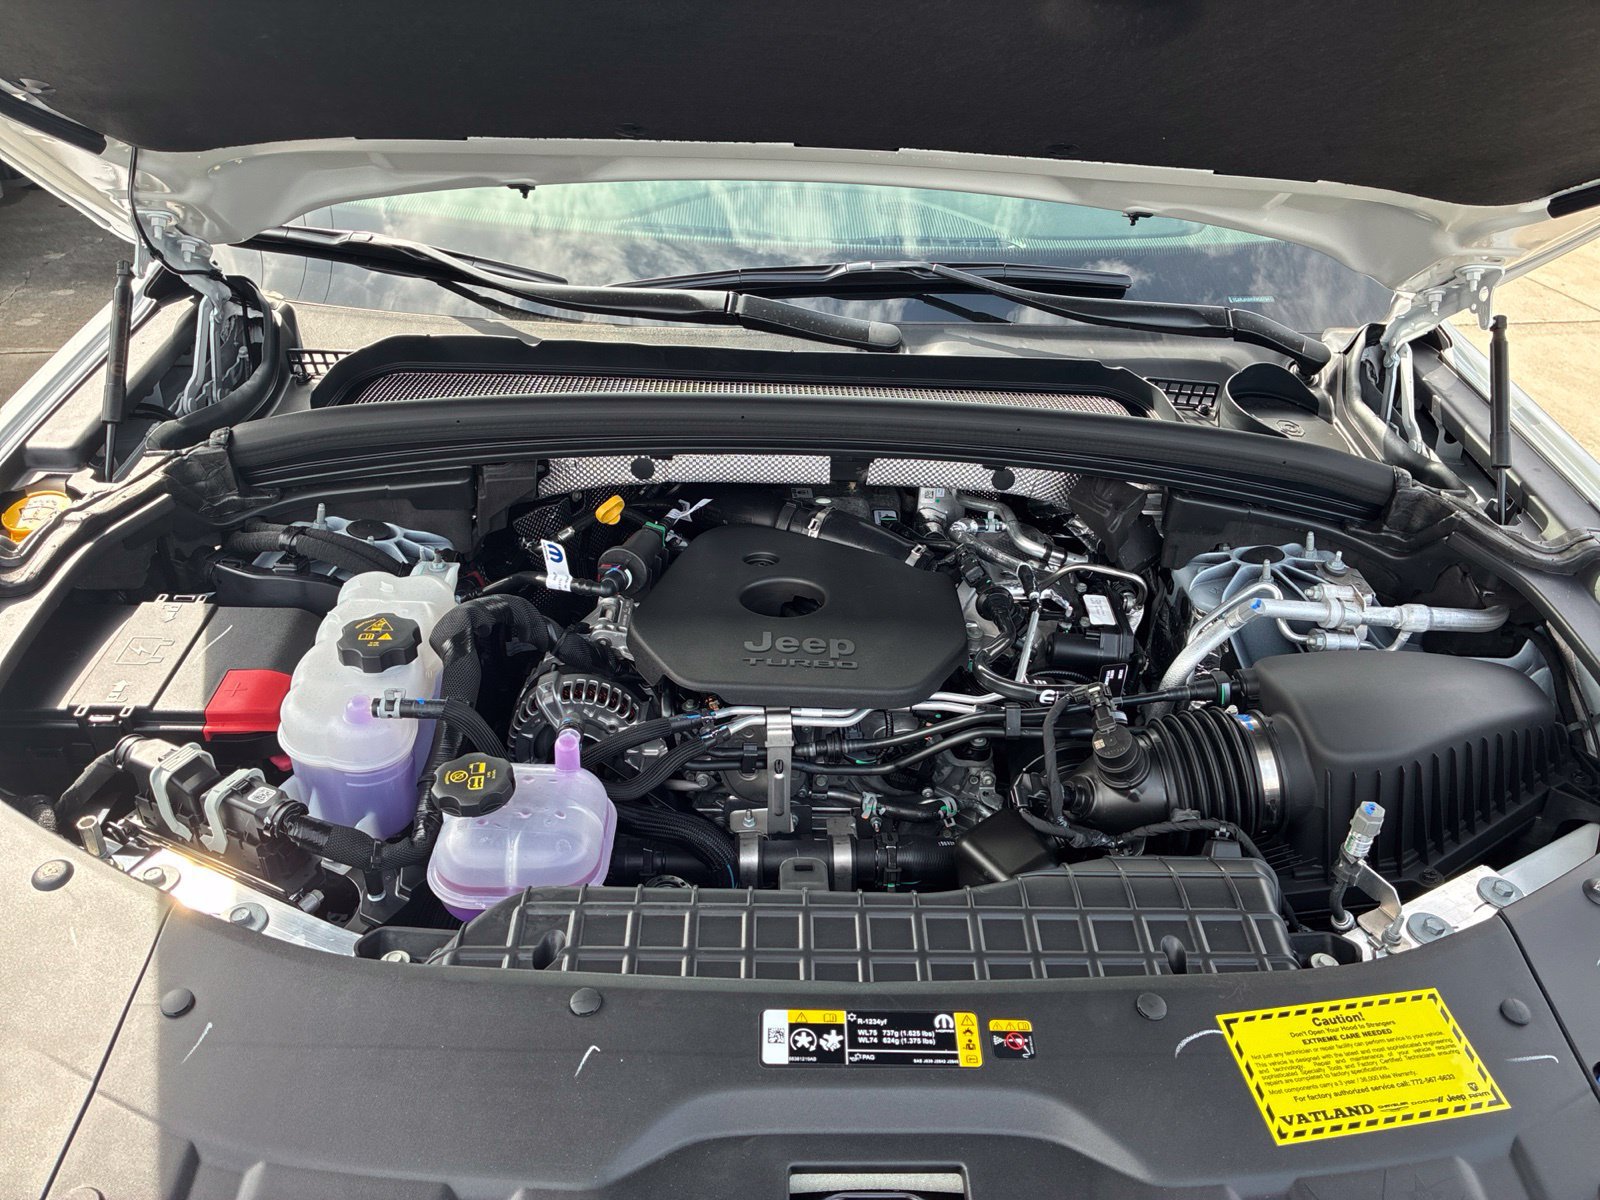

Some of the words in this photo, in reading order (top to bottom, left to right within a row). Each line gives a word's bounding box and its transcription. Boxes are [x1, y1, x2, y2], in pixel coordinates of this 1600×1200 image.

[744, 631, 856, 660] Jeep
[742, 657, 859, 670] TURBO
[857, 1018, 887, 1027] R-1234yf
[1312, 1012, 1365, 1027] Caution!
[1366, 1020, 1396, 1028] Strangers
[882, 1030, 899, 1038] 737g
[922, 1030, 935, 1038] lbs)
[1302, 1035, 1339, 1045] EXTREME
[1340, 1032, 1361, 1040] CARE
[1361, 1028, 1392, 1037] NEEDED
[1295, 1055, 1320, 1063] designed
[1387, 1042, 1422, 1051] sophisticated
[1423, 1038, 1453, 1046] engineering
[1261, 1071, 1298, 1080] sophisticated
[1300, 1068, 1325, 1076] Specialty
[1379, 1056, 1403, 1064] Certified
[1294, 1074, 1323, 1082] completed
[1350, 1066, 1389, 1075] specifications.
[1284, 1084, 1319, 1093] components
[1333, 1086, 1370, 1097] authorized
[1370, 1083, 1395, 1091] service
[1279, 1104, 1374, 1126] VATLAND
[1446, 1094, 1468, 1102] Jeep
